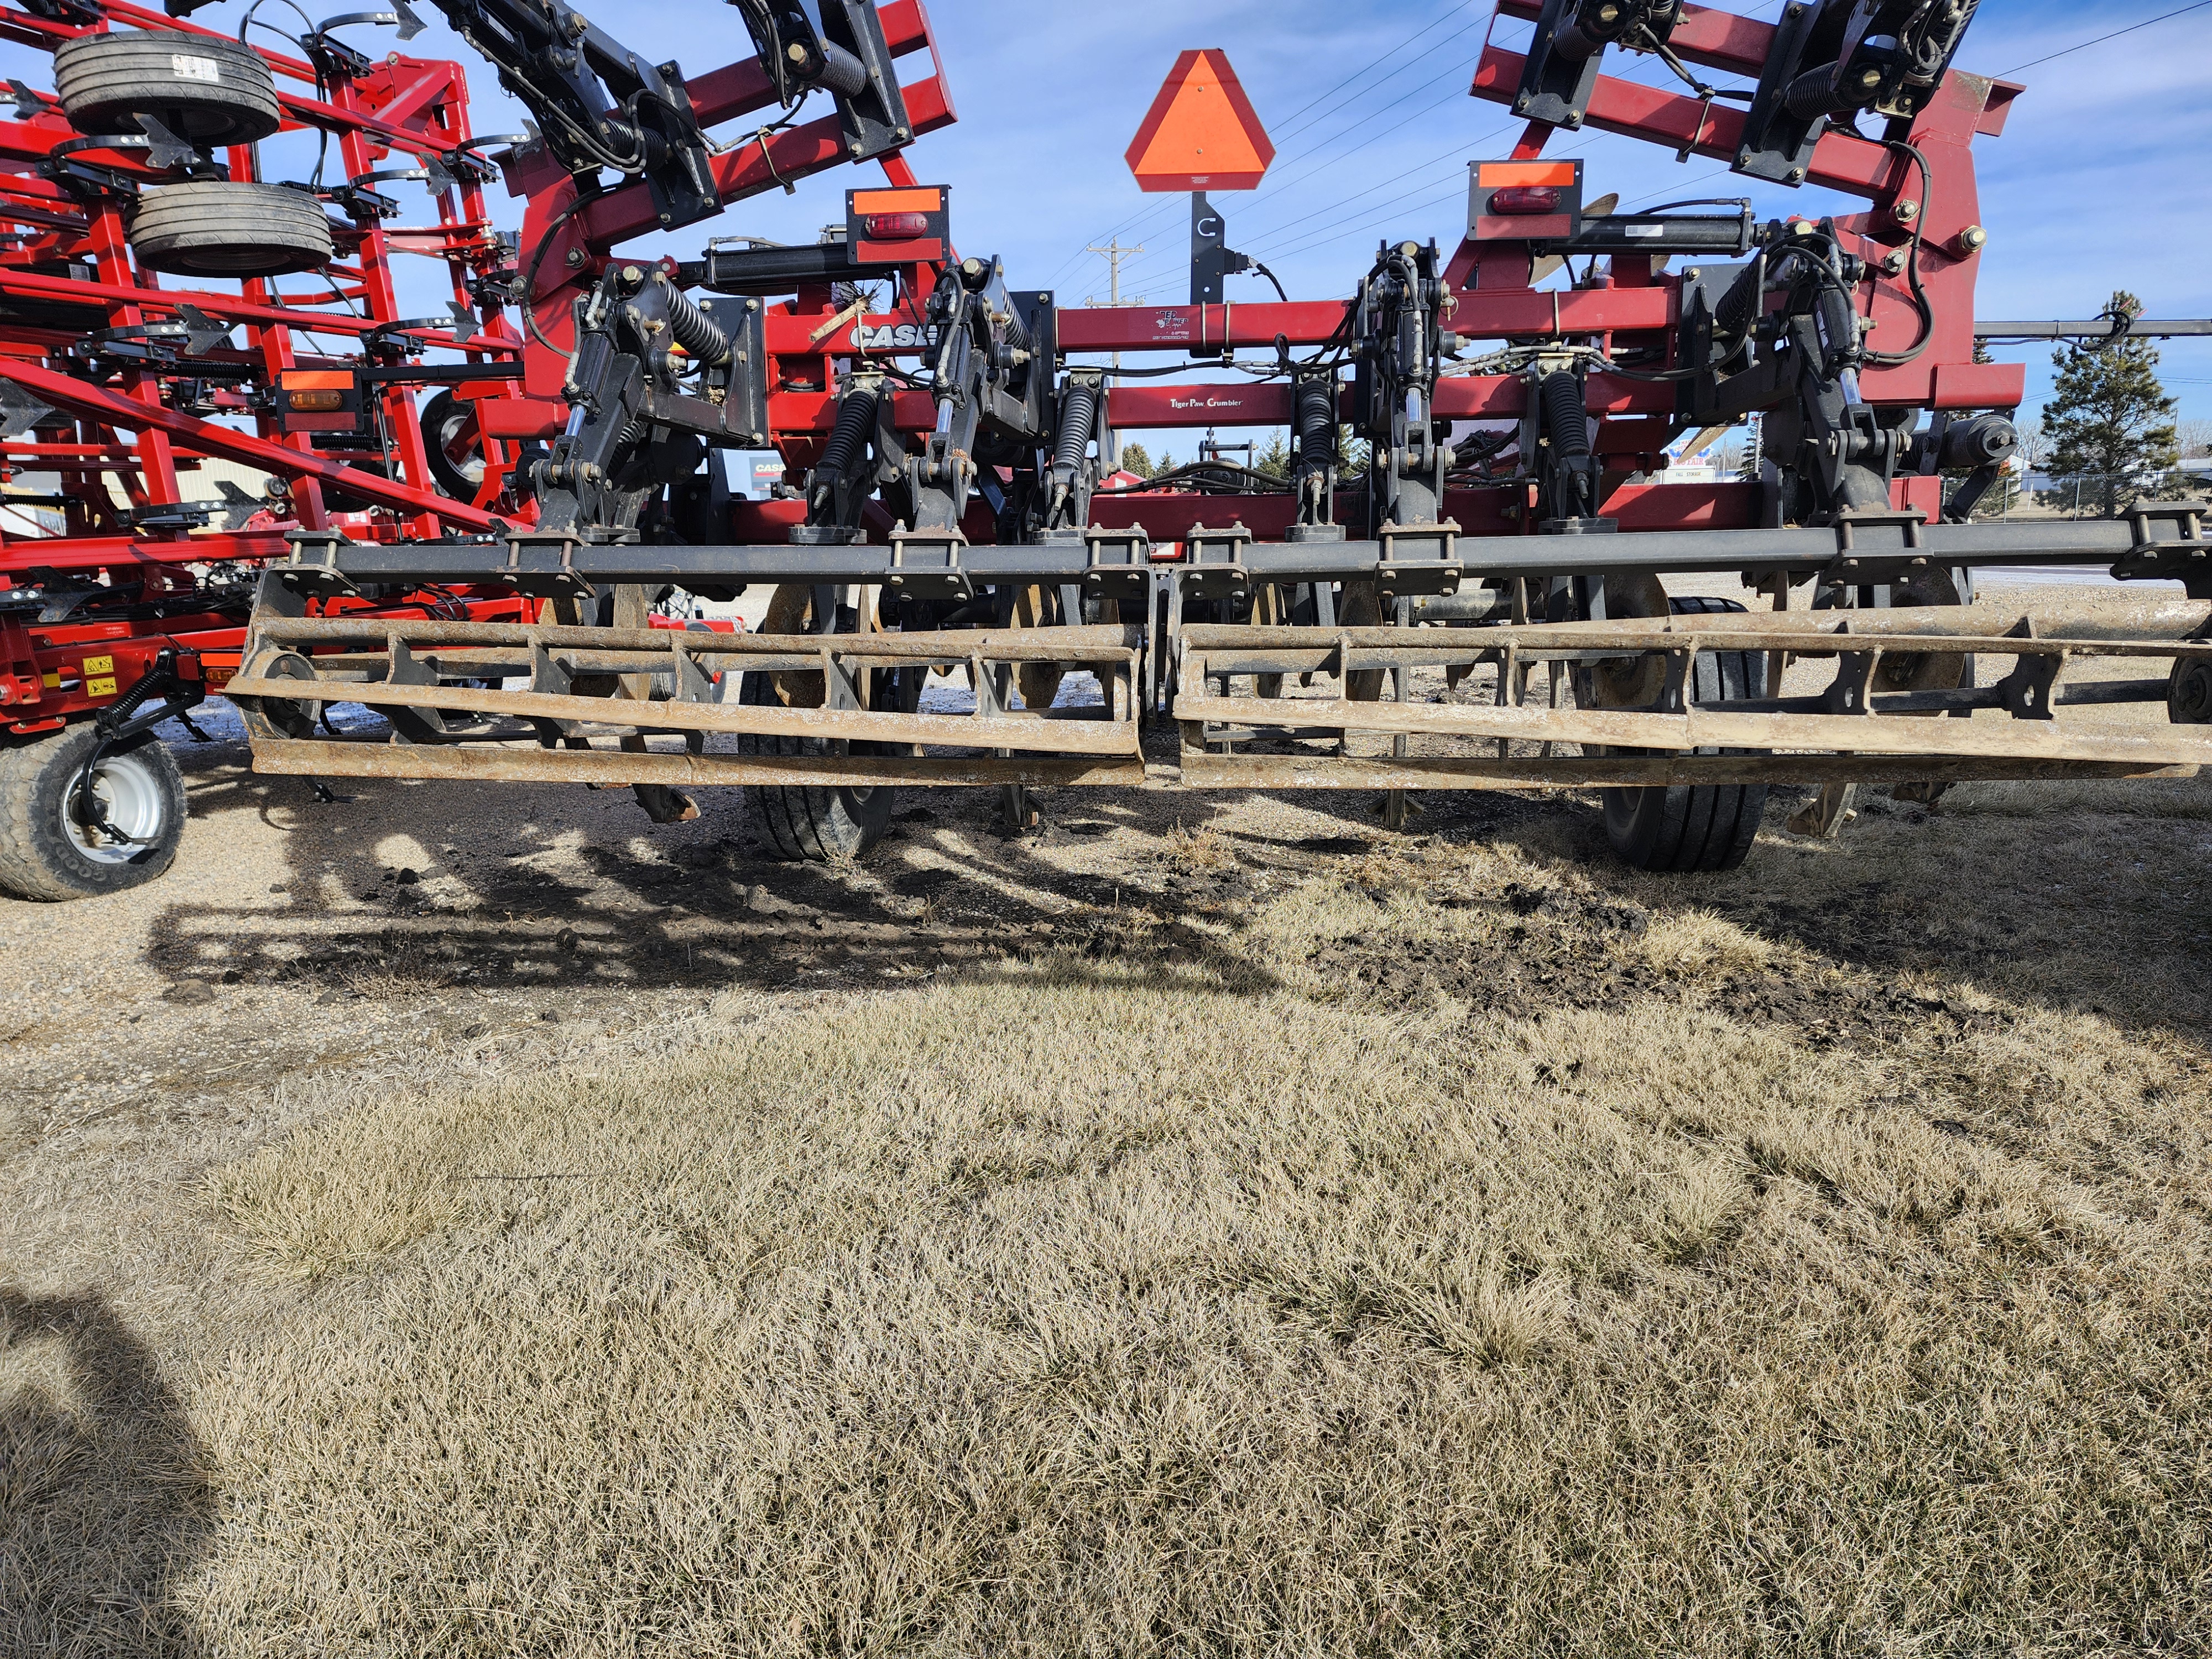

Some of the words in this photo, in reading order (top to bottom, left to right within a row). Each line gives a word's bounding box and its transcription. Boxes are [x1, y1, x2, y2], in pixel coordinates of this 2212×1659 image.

[851, 325, 938, 347] CASE
[1170, 399, 1190, 409] Tiger
[755, 464, 787, 472] CASE
